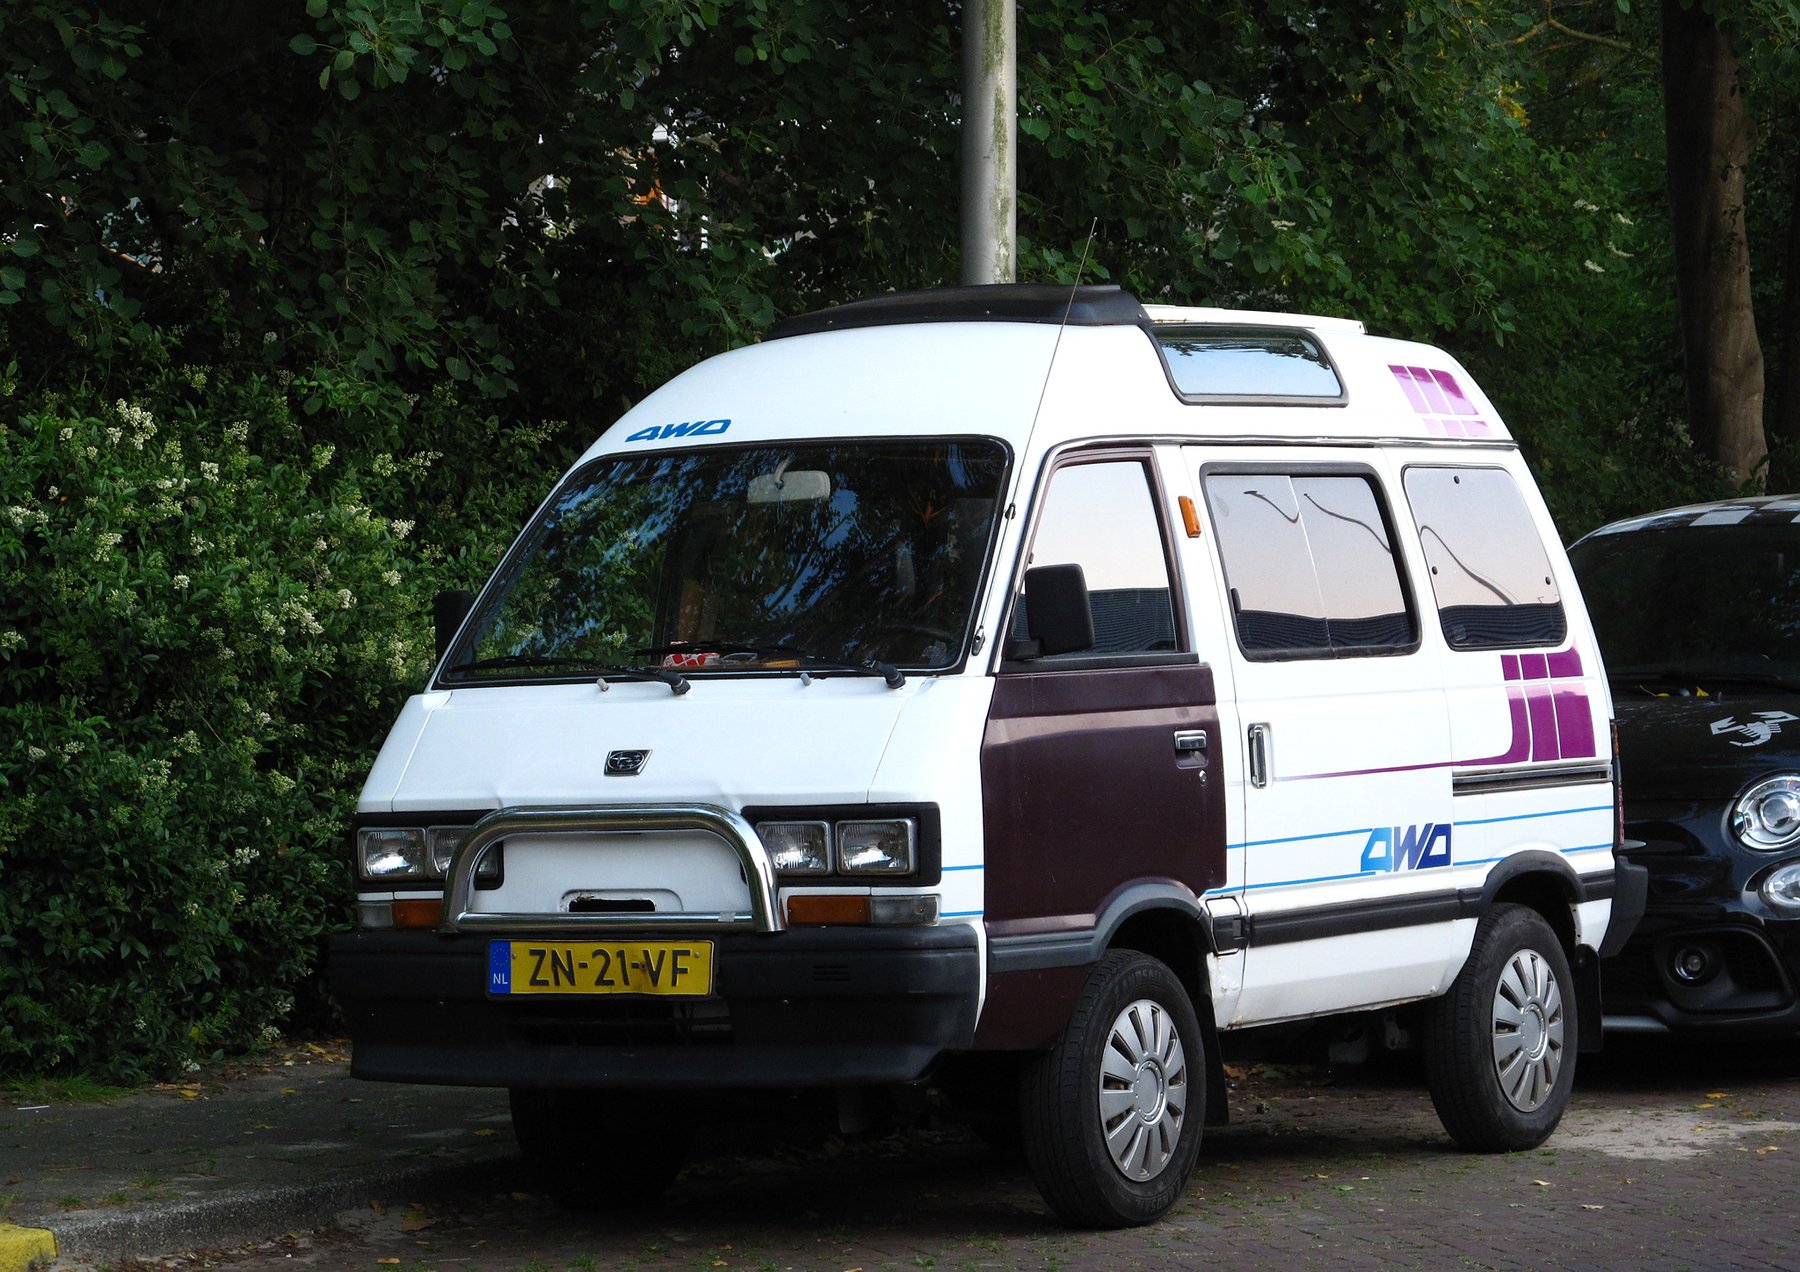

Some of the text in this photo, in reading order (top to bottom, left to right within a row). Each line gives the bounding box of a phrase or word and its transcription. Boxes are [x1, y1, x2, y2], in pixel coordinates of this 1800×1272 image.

[625, 419, 731, 442] 4WD
[1361, 822, 1452, 873] 4WD
[492, 973, 508, 985] NL
[529, 948, 691, 987] ZN-21-VF
